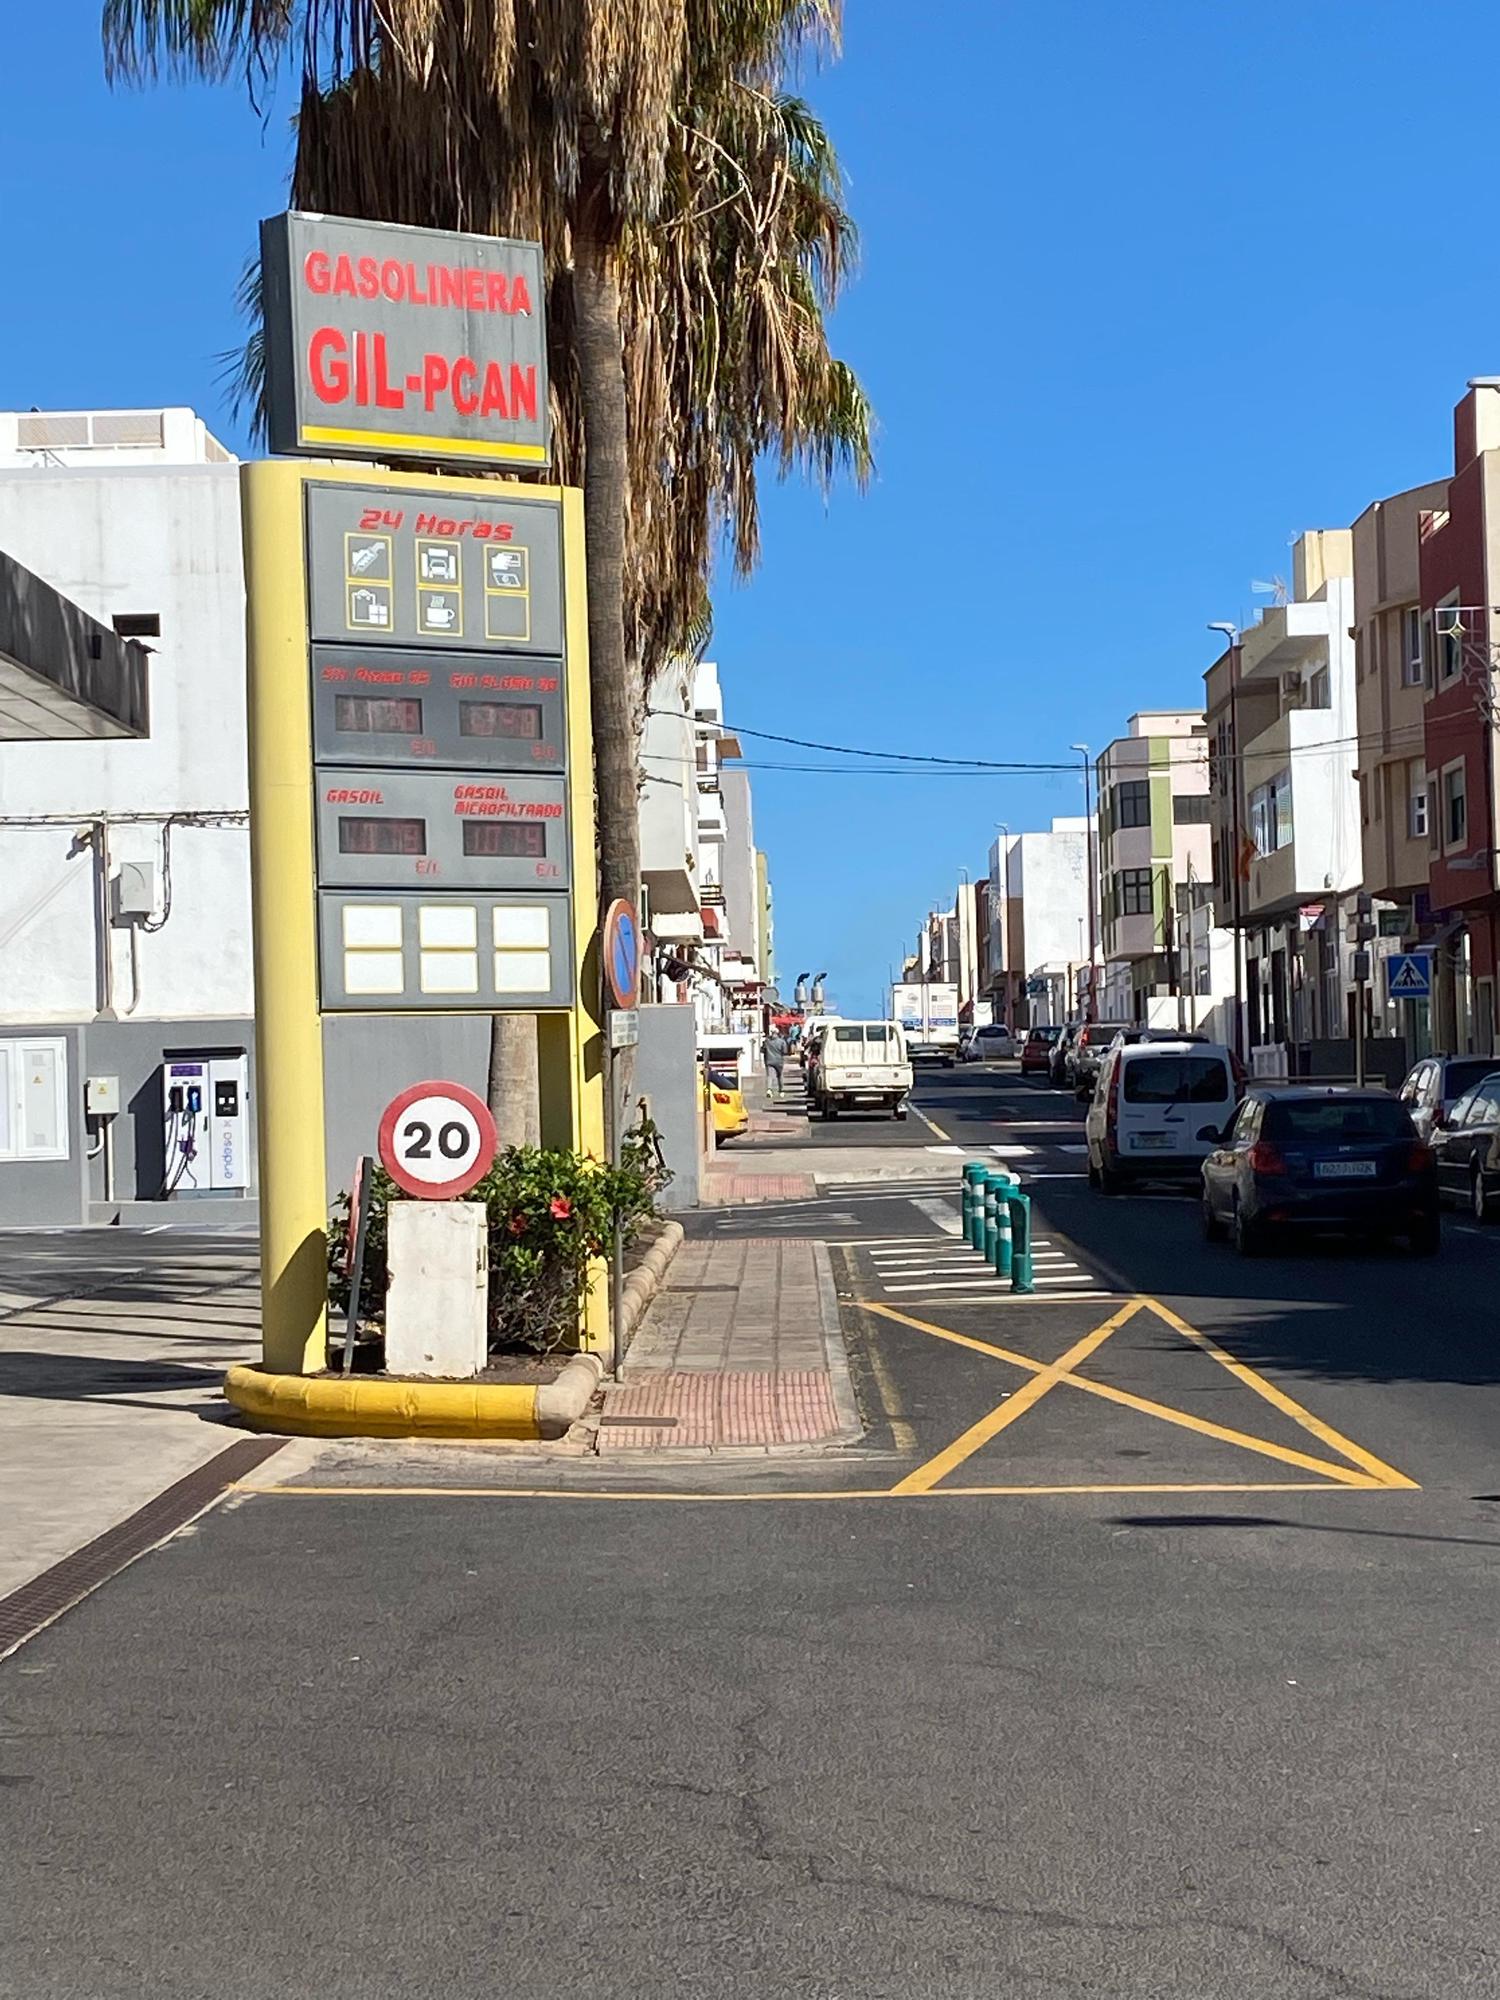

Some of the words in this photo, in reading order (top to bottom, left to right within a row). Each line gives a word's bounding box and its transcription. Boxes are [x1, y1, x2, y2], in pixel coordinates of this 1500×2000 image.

[304, 250, 533, 317] GASOLINERA
[308, 326, 538, 422] GIL-PCAN
[359, 508, 404, 531] 24
[415, 513, 515, 542] Horas
[326, 788, 384, 804] GASOIL
[454, 784, 508, 800] GASOIL
[403, 1120, 471, 1159] 20
